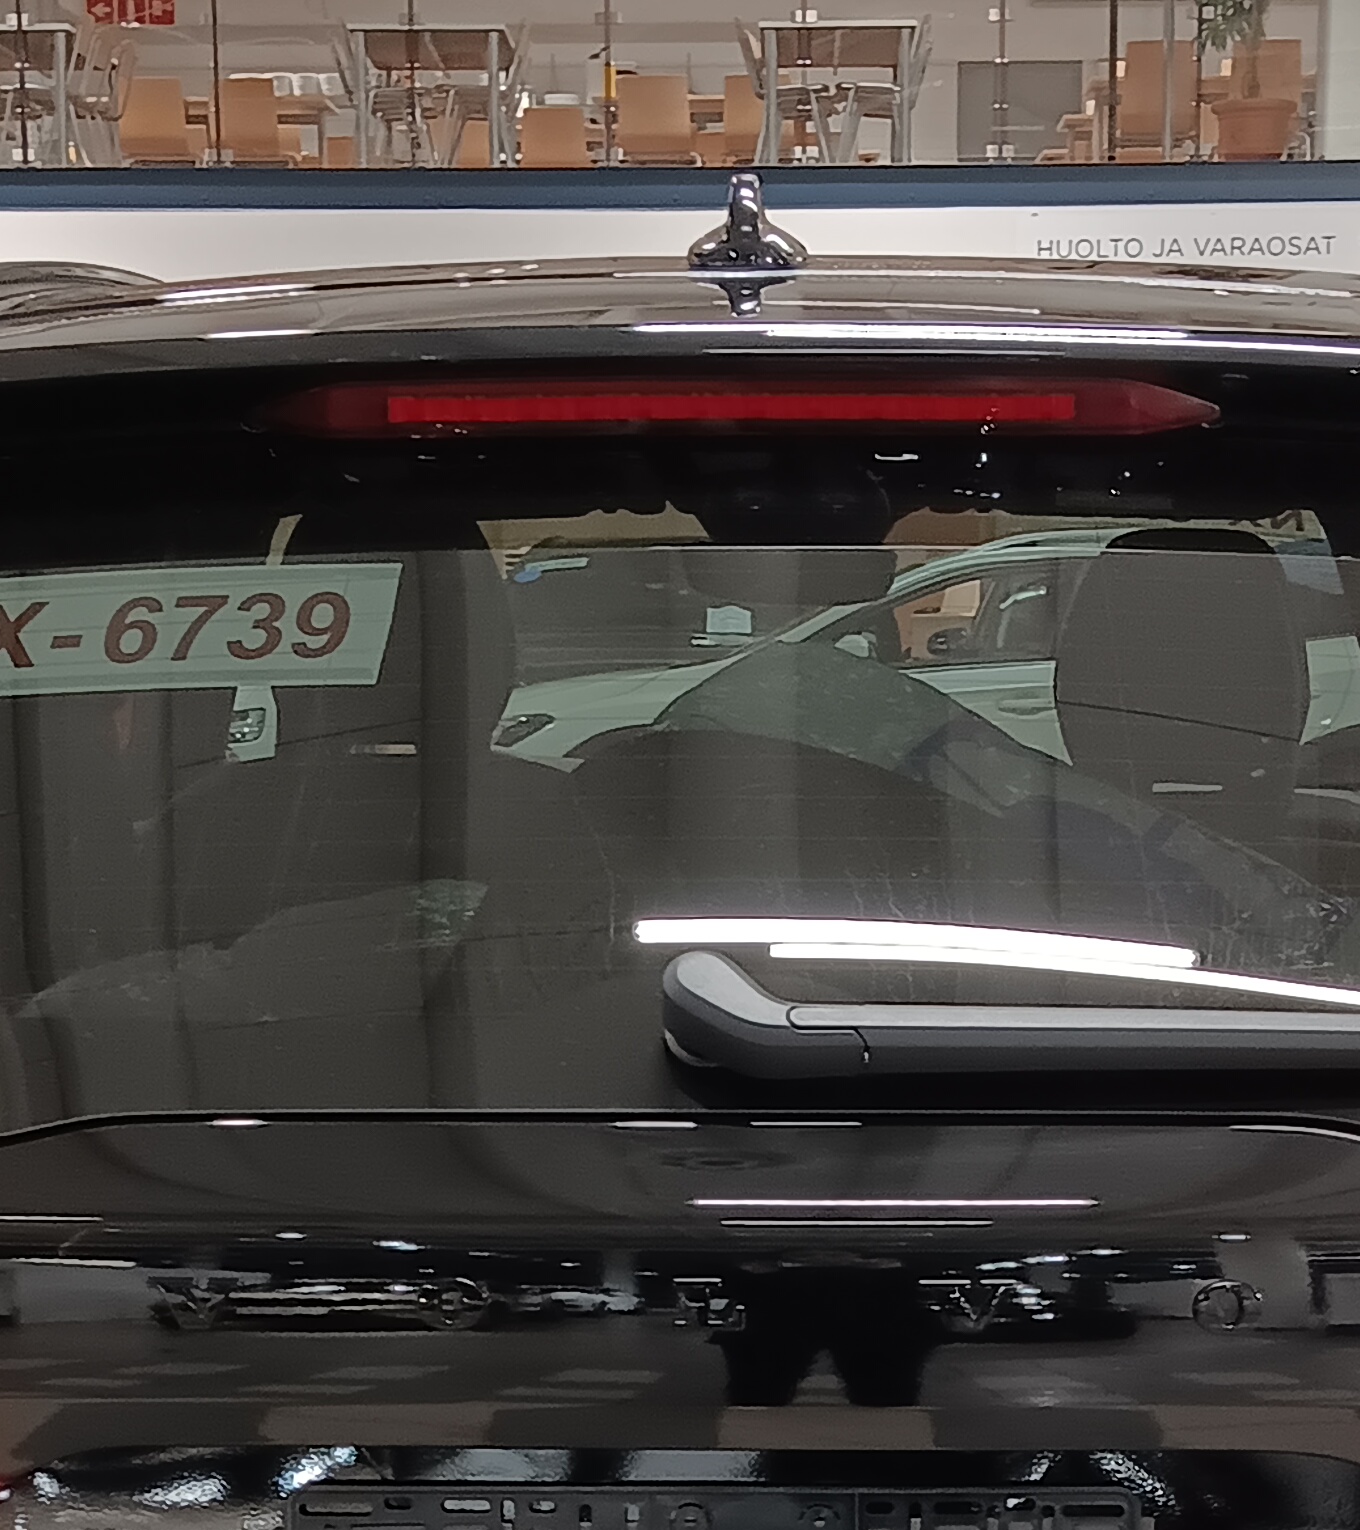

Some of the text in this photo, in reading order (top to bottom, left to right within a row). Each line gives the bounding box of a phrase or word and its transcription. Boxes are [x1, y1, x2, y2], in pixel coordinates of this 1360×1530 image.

[1036, 235, 1336, 259] HUOLTO JA VARAOSAT
